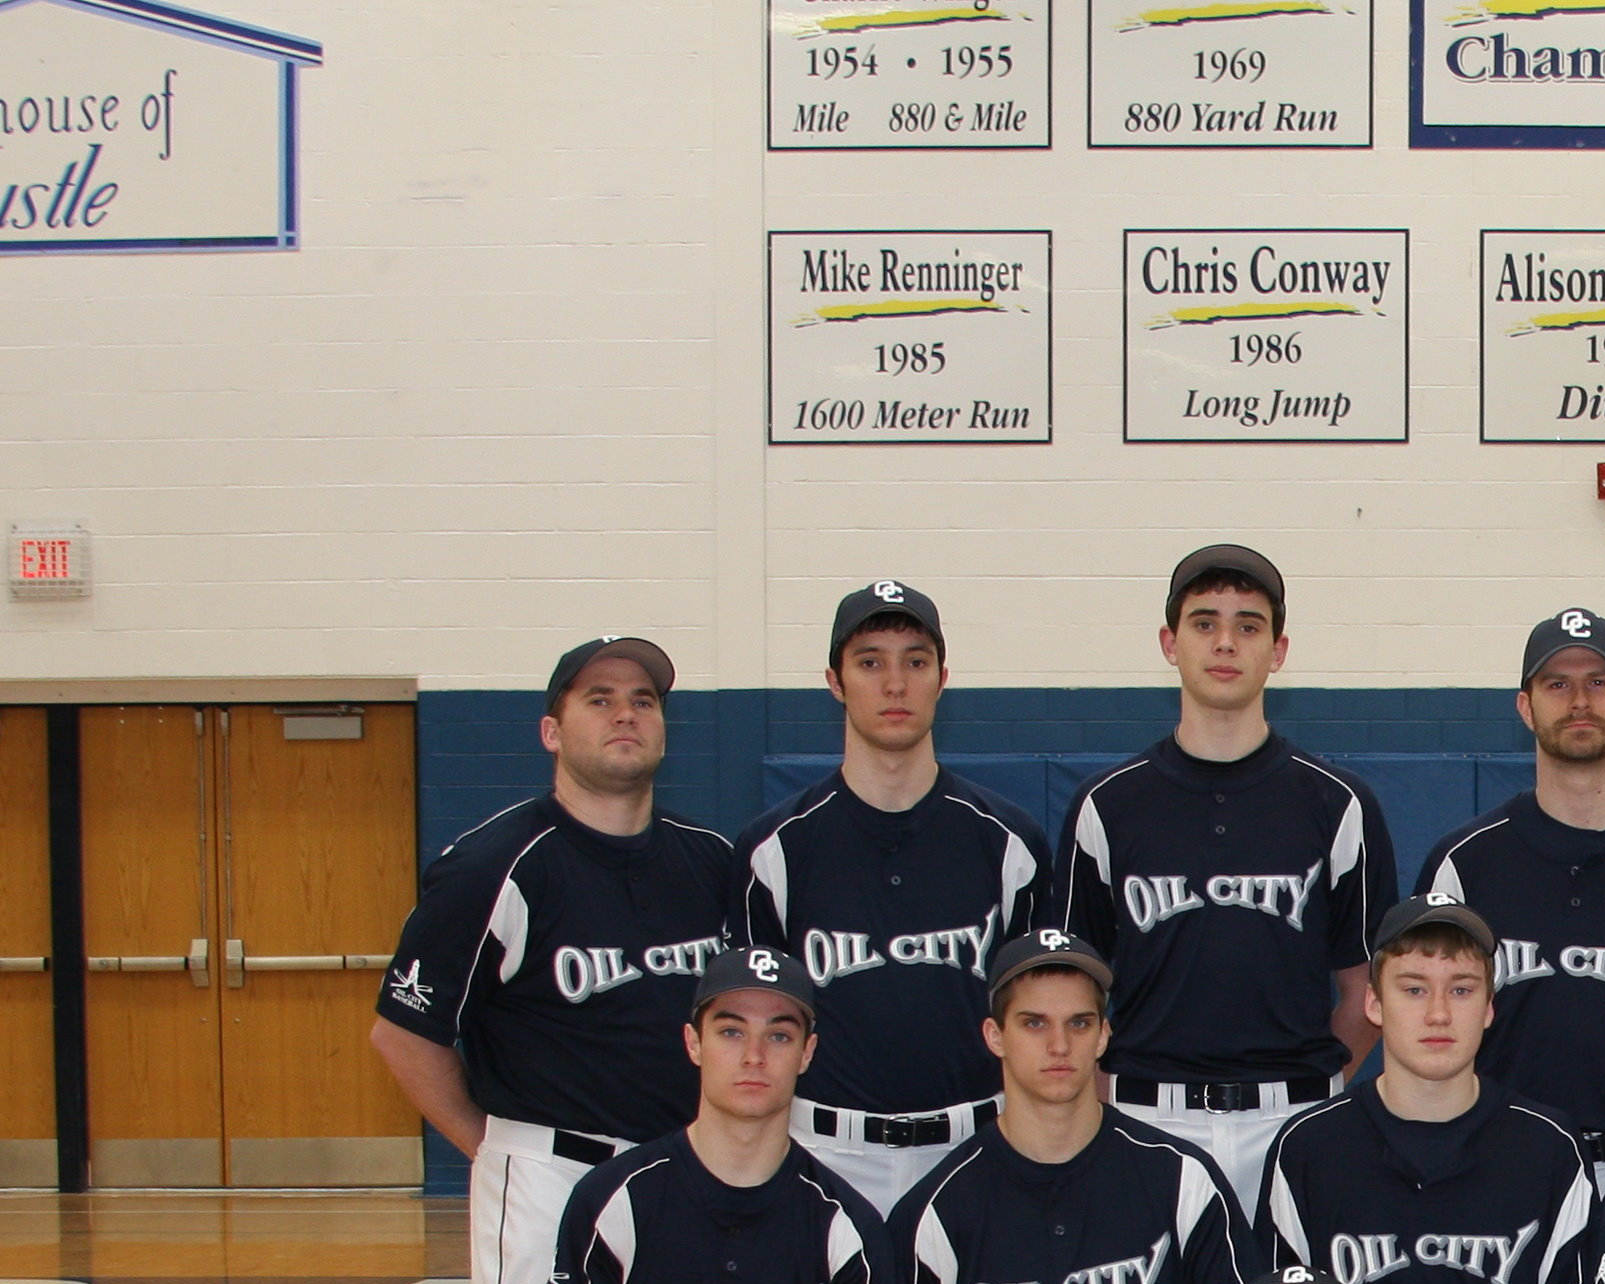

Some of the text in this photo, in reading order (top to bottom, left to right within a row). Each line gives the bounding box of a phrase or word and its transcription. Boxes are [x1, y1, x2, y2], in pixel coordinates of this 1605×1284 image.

[805, 45, 1013, 79] 1954 1955
[1193, 50, 1266, 84] 1969
[141, 69, 177, 160] of
[793, 102, 1028, 133] Mile 880 & Mile
[1124, 102, 1339, 133] 880 Yard Run
[800, 249, 1024, 301] Mike Renninger
[1142, 246, 1391, 304] Chris Conway
[874, 342, 946, 377] 1985
[1228, 331, 1302, 367] 1986
[795, 399, 1031, 430] 1600 Meter Run
[1182, 389, 1352, 426] Long Jump
[21, 540, 72, 579] EXIT
[875, 580, 905, 603] OC
[1561, 610, 1592, 638] OC
[1123, 858, 1323, 932] OIL CITY
[804, 903, 1000, 988] OIL CITY
[554, 944, 642, 1002] OIL
[749, 949, 780, 983] OC
